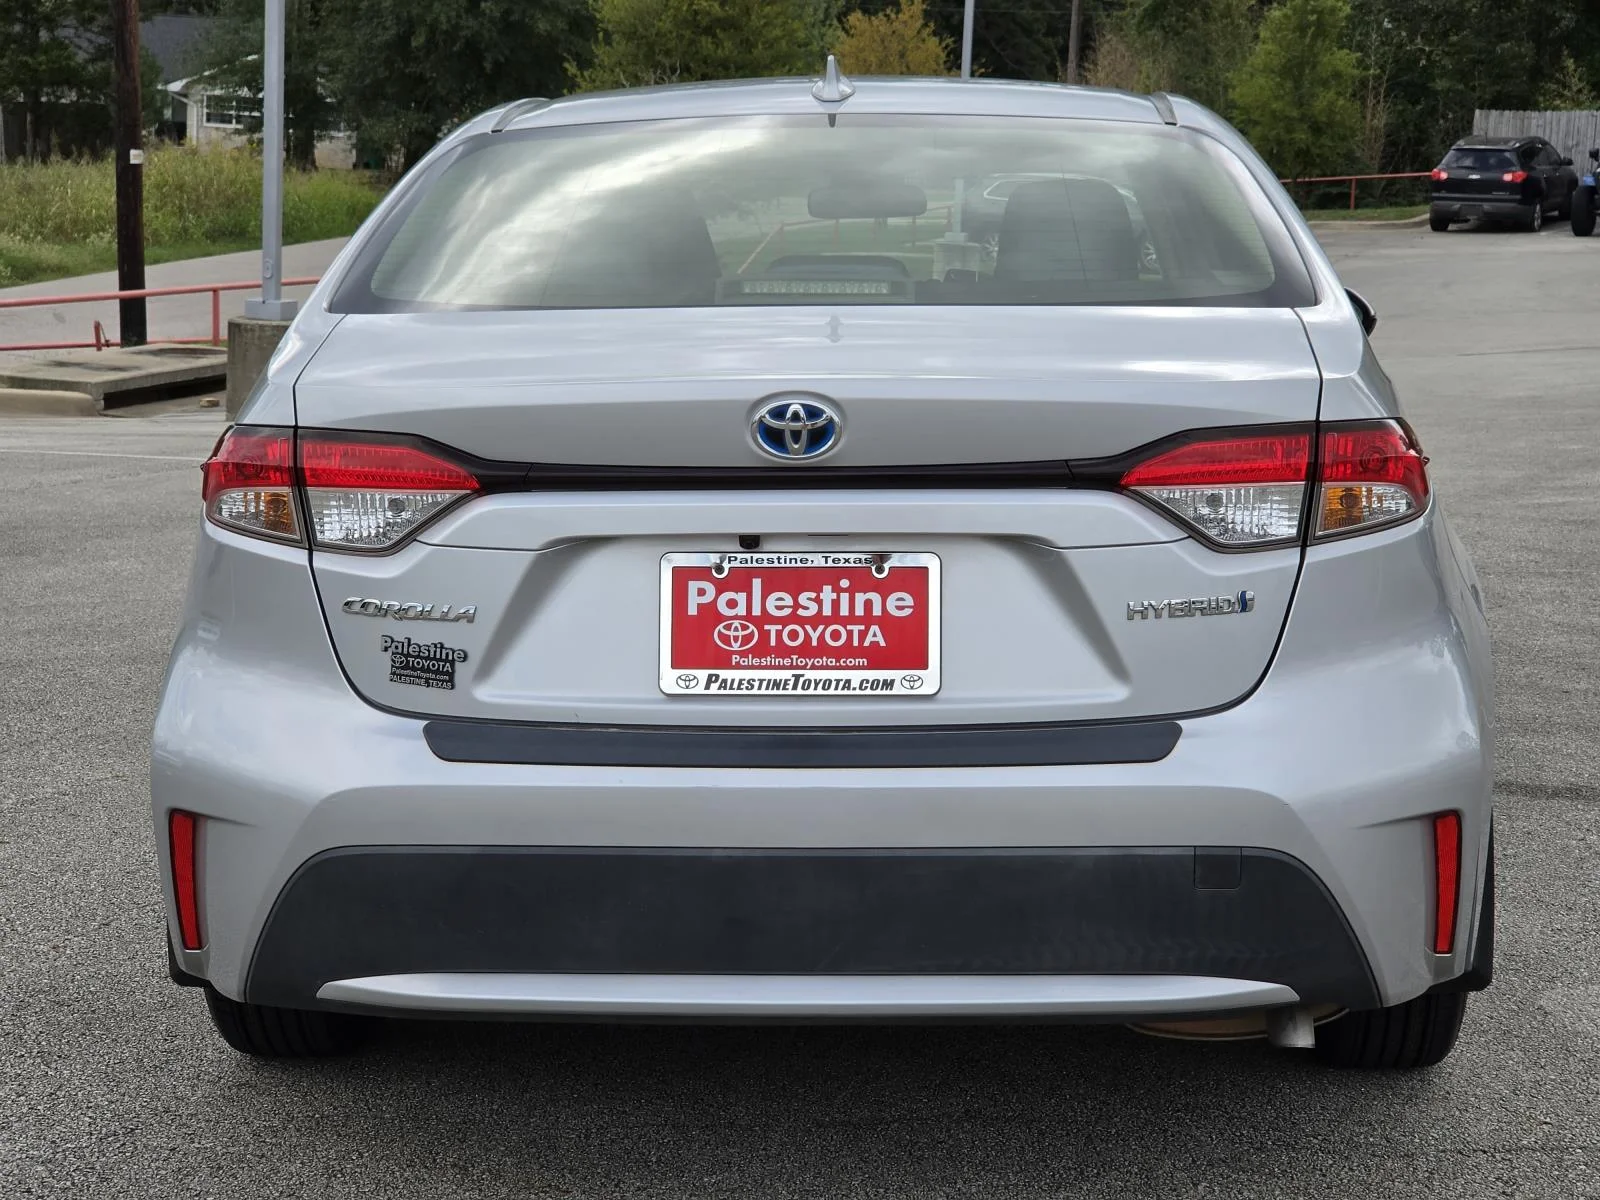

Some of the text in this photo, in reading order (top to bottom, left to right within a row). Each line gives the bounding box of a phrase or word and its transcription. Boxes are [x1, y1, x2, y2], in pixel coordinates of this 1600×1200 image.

[727, 555, 873, 566] Palestine, Texas
[687, 577, 915, 617] Palestine
[343, 597, 476, 623] COROLLA
[1127, 595, 1234, 620] HYBRID
[764, 624, 886, 647] TOYOTA
[381, 635, 468, 662] Palestine
[408, 657, 452, 673] TOYOTA
[731, 655, 868, 669] PalestineToyota.com
[389, 674, 452, 690] PALESTINE, TEXAS
[391, 667, 449, 680] PalestineToyota.com
